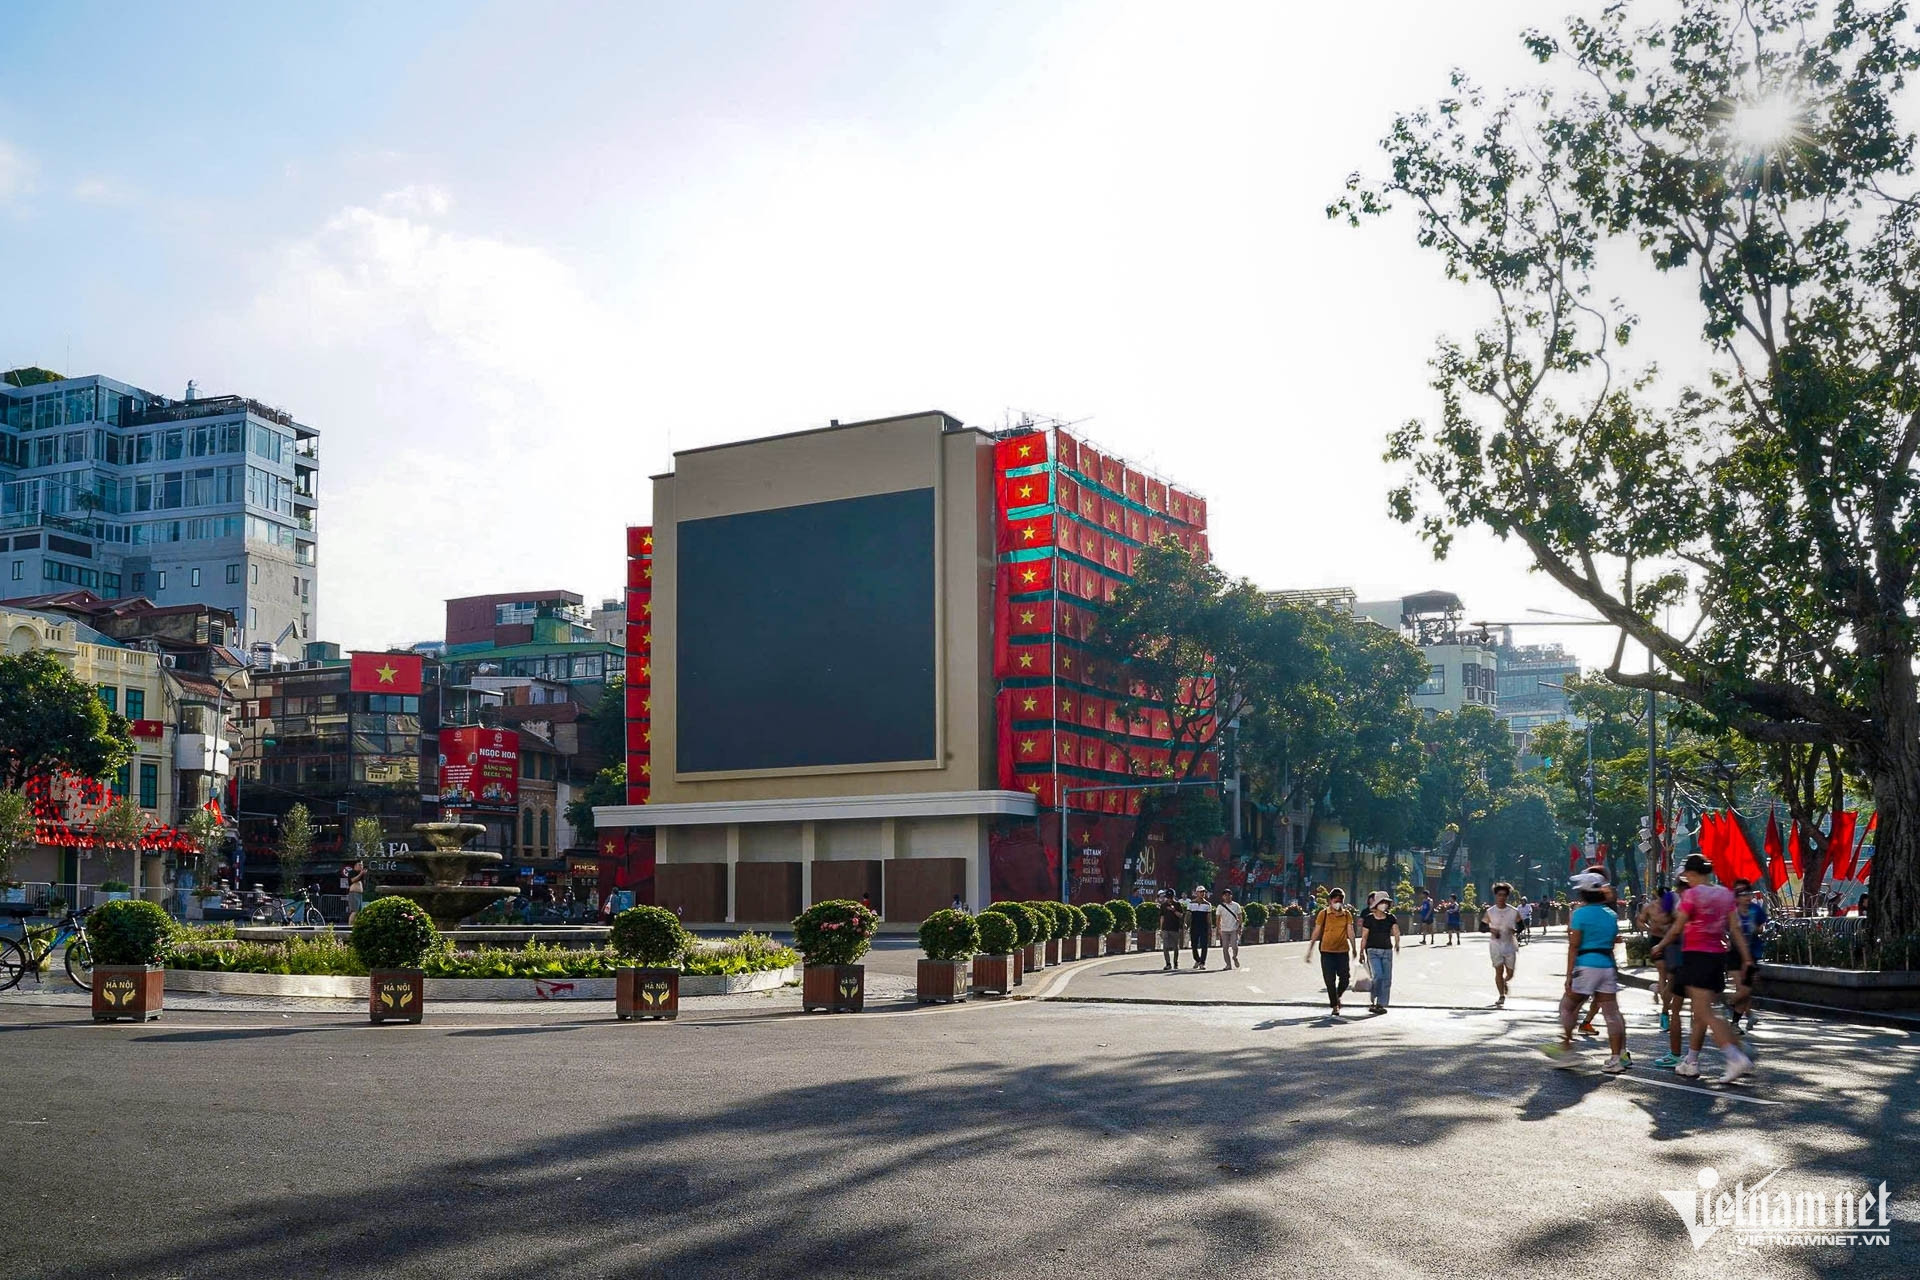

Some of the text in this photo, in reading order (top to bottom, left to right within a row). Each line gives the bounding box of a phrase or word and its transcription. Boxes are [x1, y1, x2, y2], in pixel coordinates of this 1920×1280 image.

[479, 748, 499, 758] NGỌC
[369, 860, 397, 871] Café
[106, 979, 133, 990] HÀ NỘI
[383, 982, 411, 992] HÀ NỘI
[644, 981, 668, 991] HÀ NỘI
